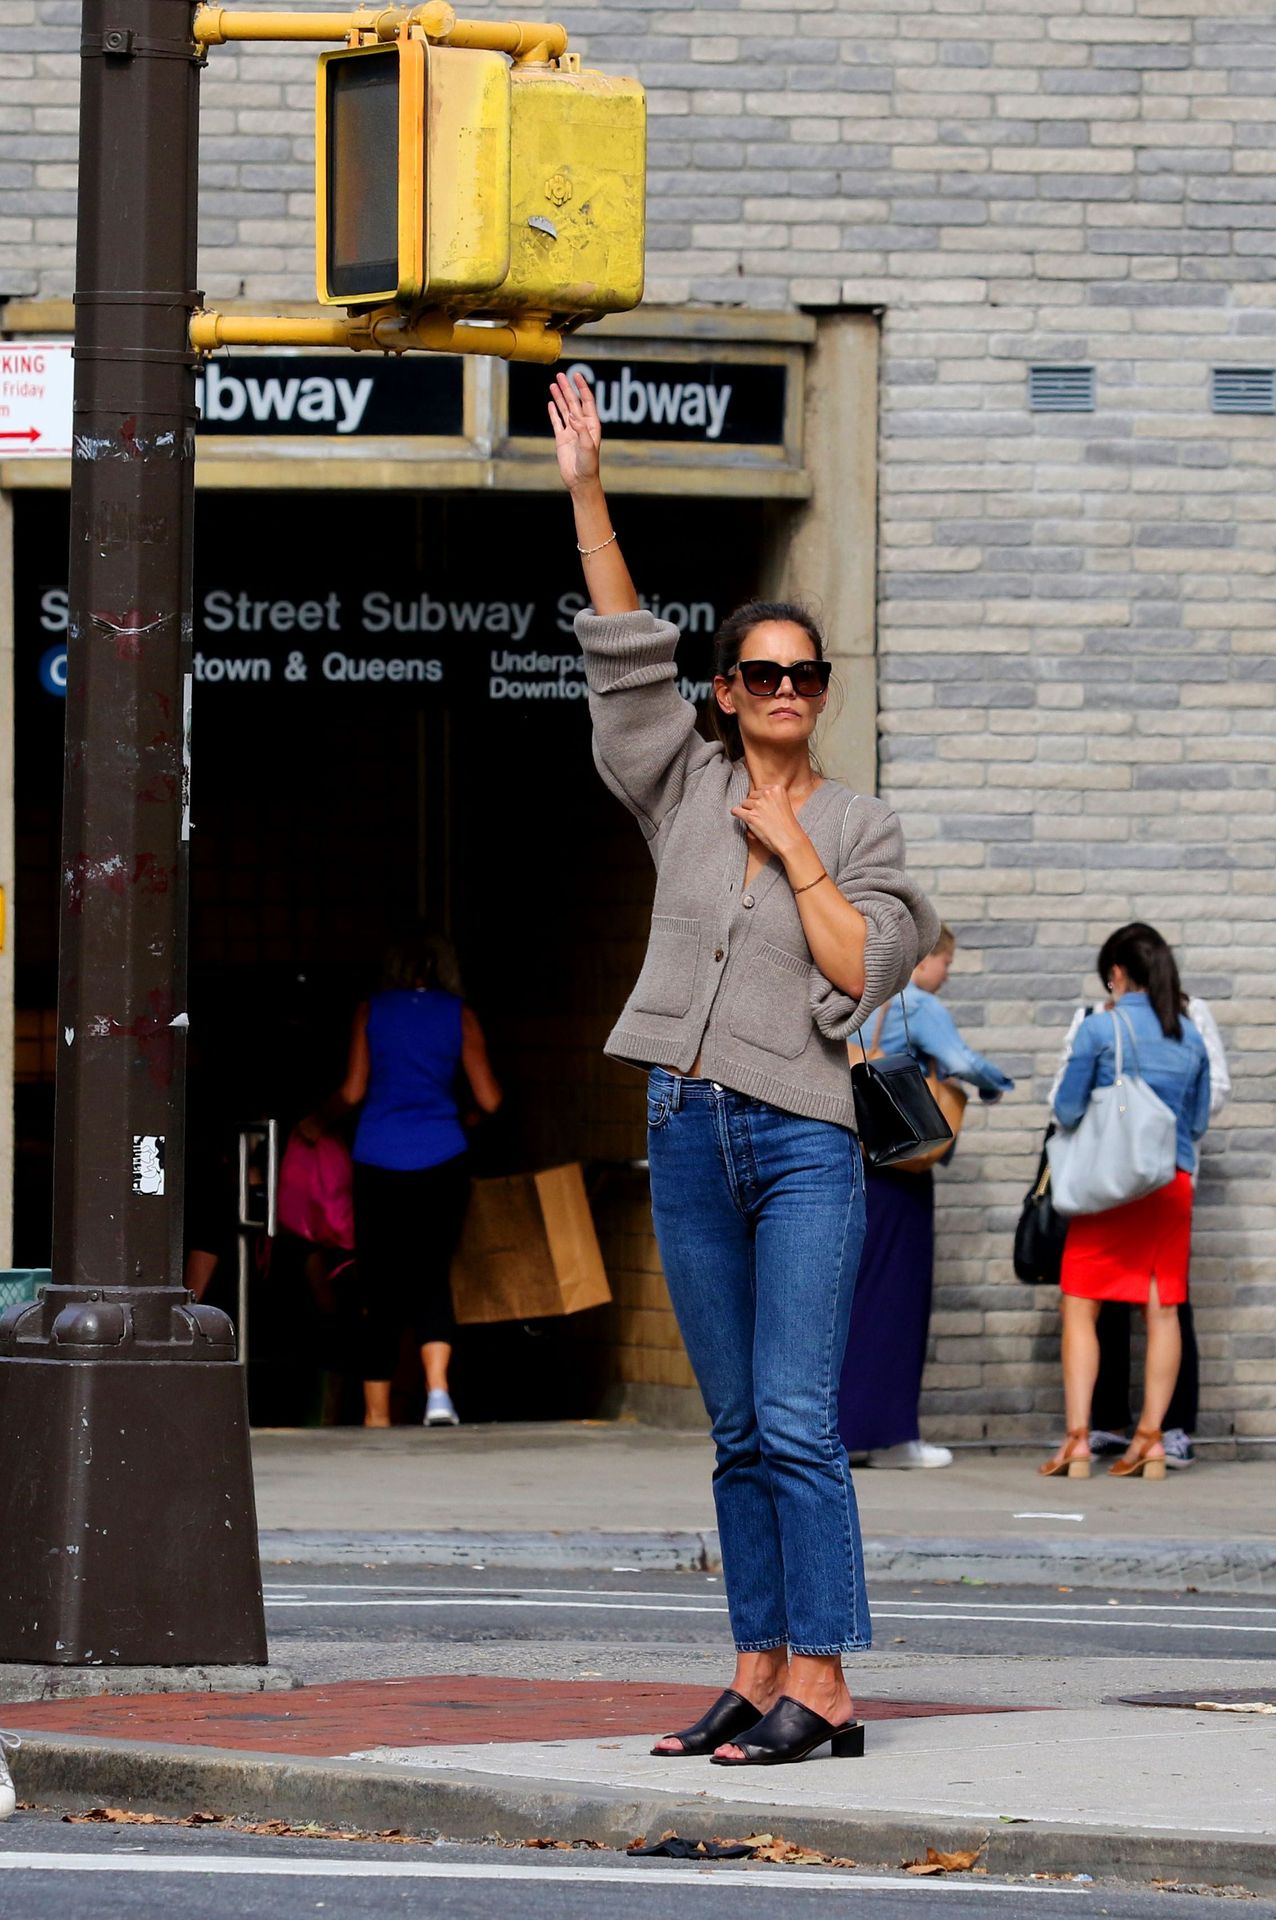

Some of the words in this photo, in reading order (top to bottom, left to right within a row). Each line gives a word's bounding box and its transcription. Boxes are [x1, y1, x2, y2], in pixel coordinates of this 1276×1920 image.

[0, 354, 46, 374] KING
[3, 380, 45, 399] Friday
[195, 363, 373, 433] bway
[204, 591, 340, 631] Street
[363, 593, 533, 640] Subway
[193, 652, 271, 682] town
[284, 652, 307, 682] &
[322, 652, 443, 682] Queens
[490, 650, 585, 677] Underpa
